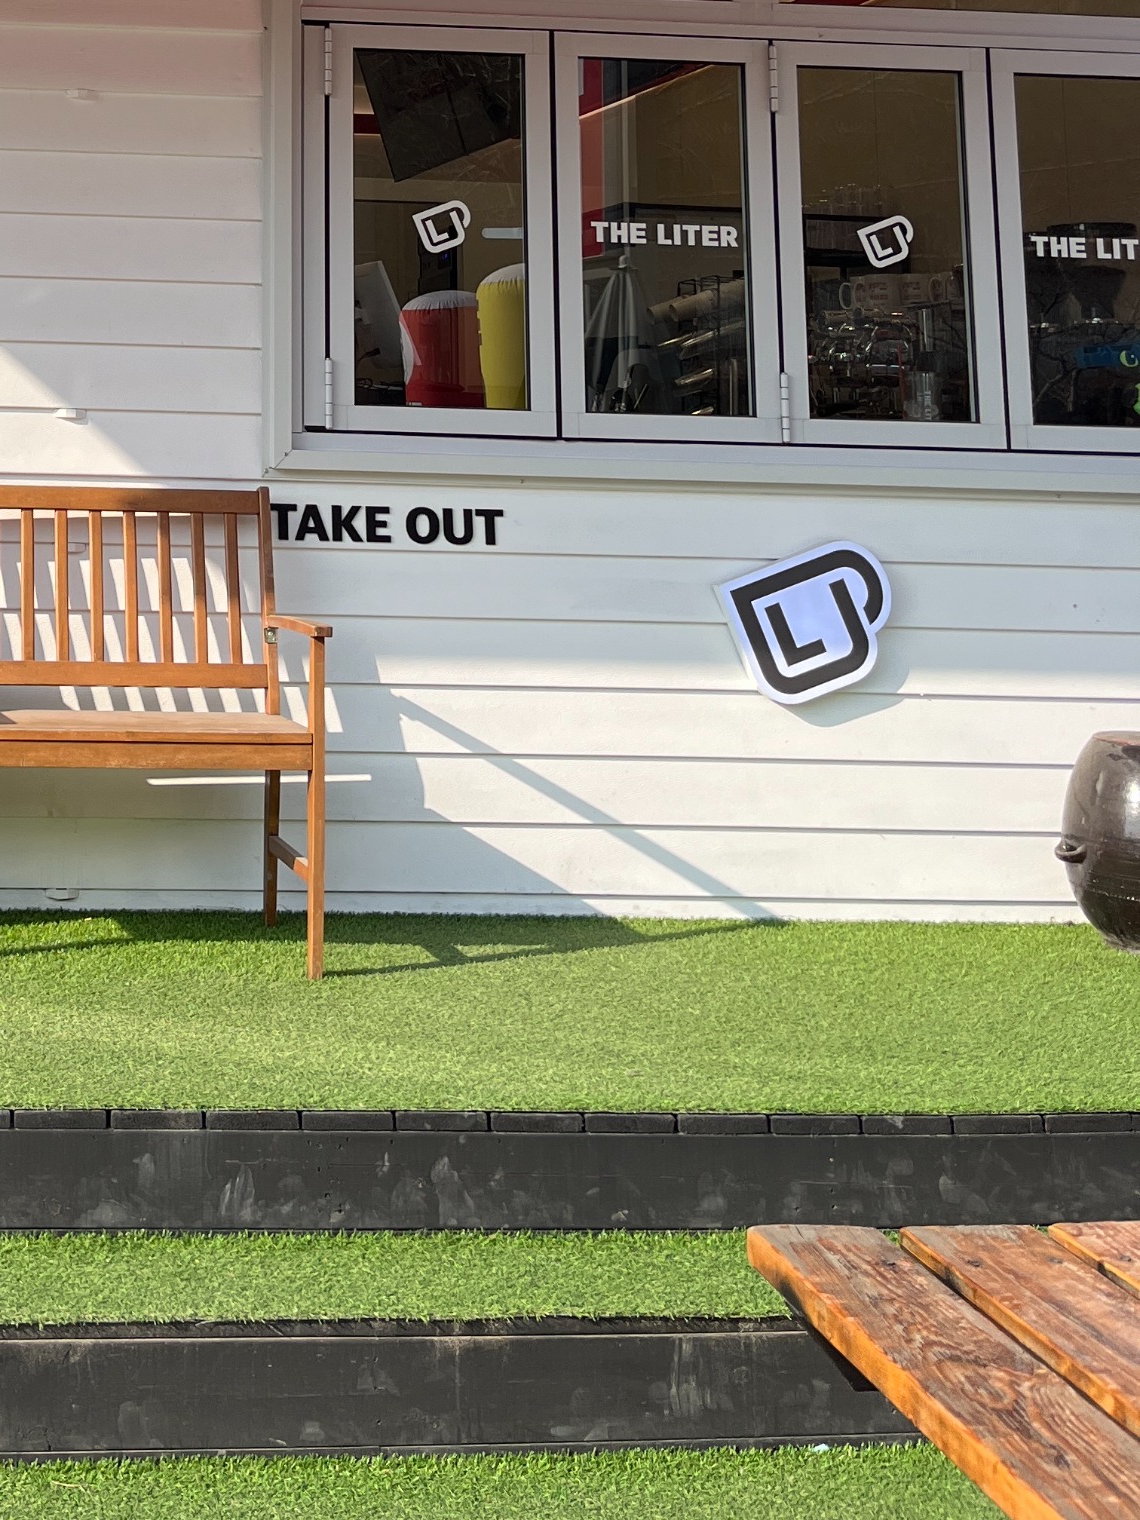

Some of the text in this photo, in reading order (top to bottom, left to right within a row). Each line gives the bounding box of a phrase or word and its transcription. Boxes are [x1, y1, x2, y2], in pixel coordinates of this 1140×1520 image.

[590, 220, 739, 248] THE LITER
[1030, 235, 1087, 259] THE
[270, 502, 504, 546] TAKE OUT
